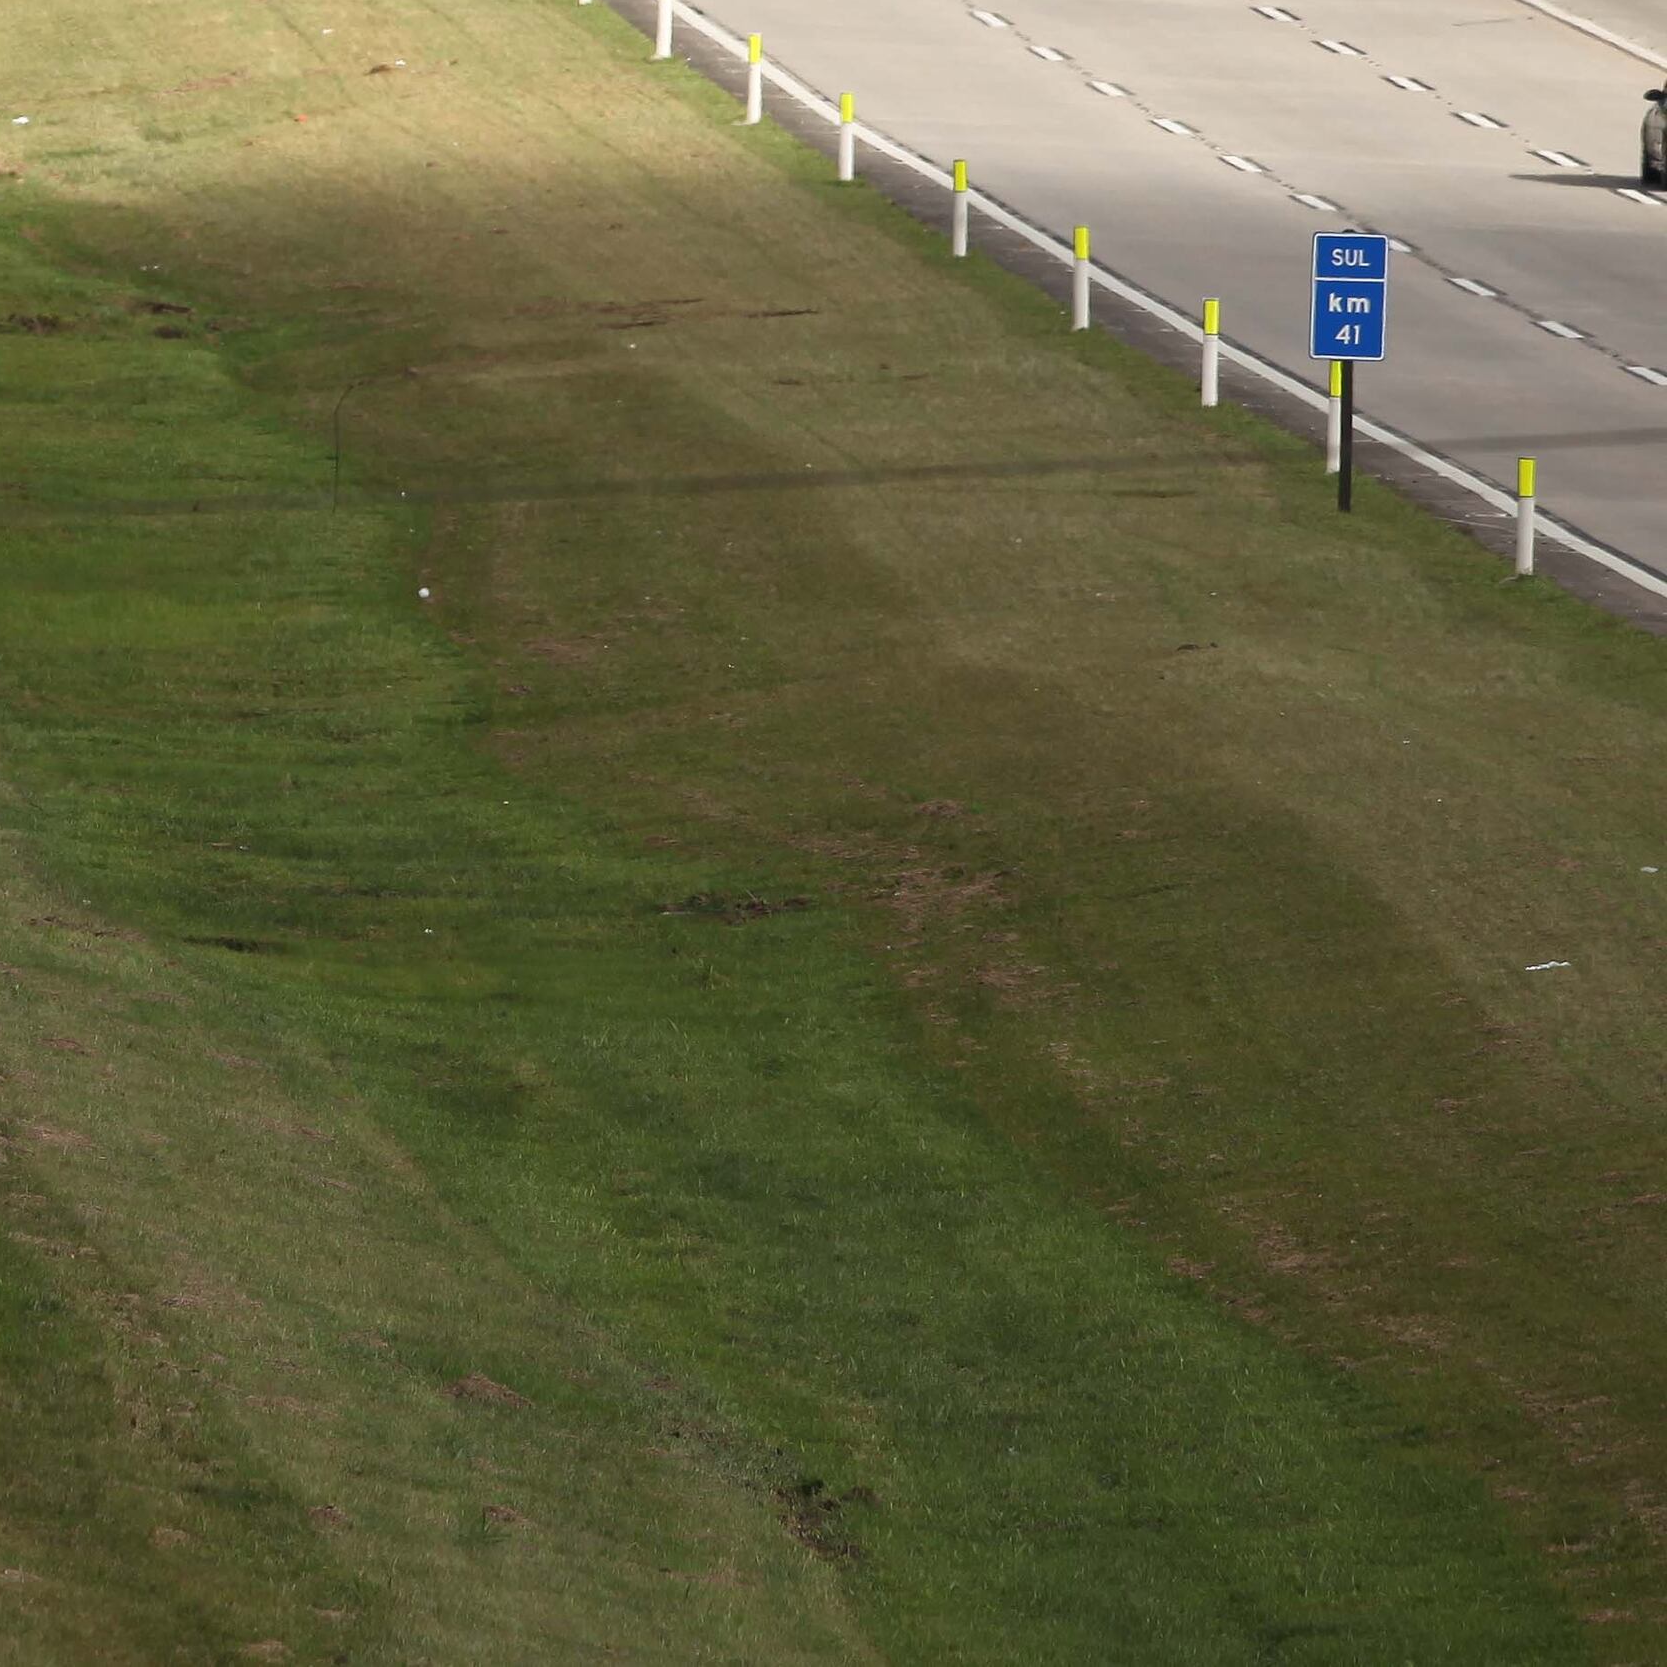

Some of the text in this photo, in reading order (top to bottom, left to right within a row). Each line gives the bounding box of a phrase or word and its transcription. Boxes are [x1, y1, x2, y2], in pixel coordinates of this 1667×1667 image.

[1331, 248, 1371, 267] SUL
[1328, 292, 1371, 314] km
[1335, 324, 1362, 345] 41
